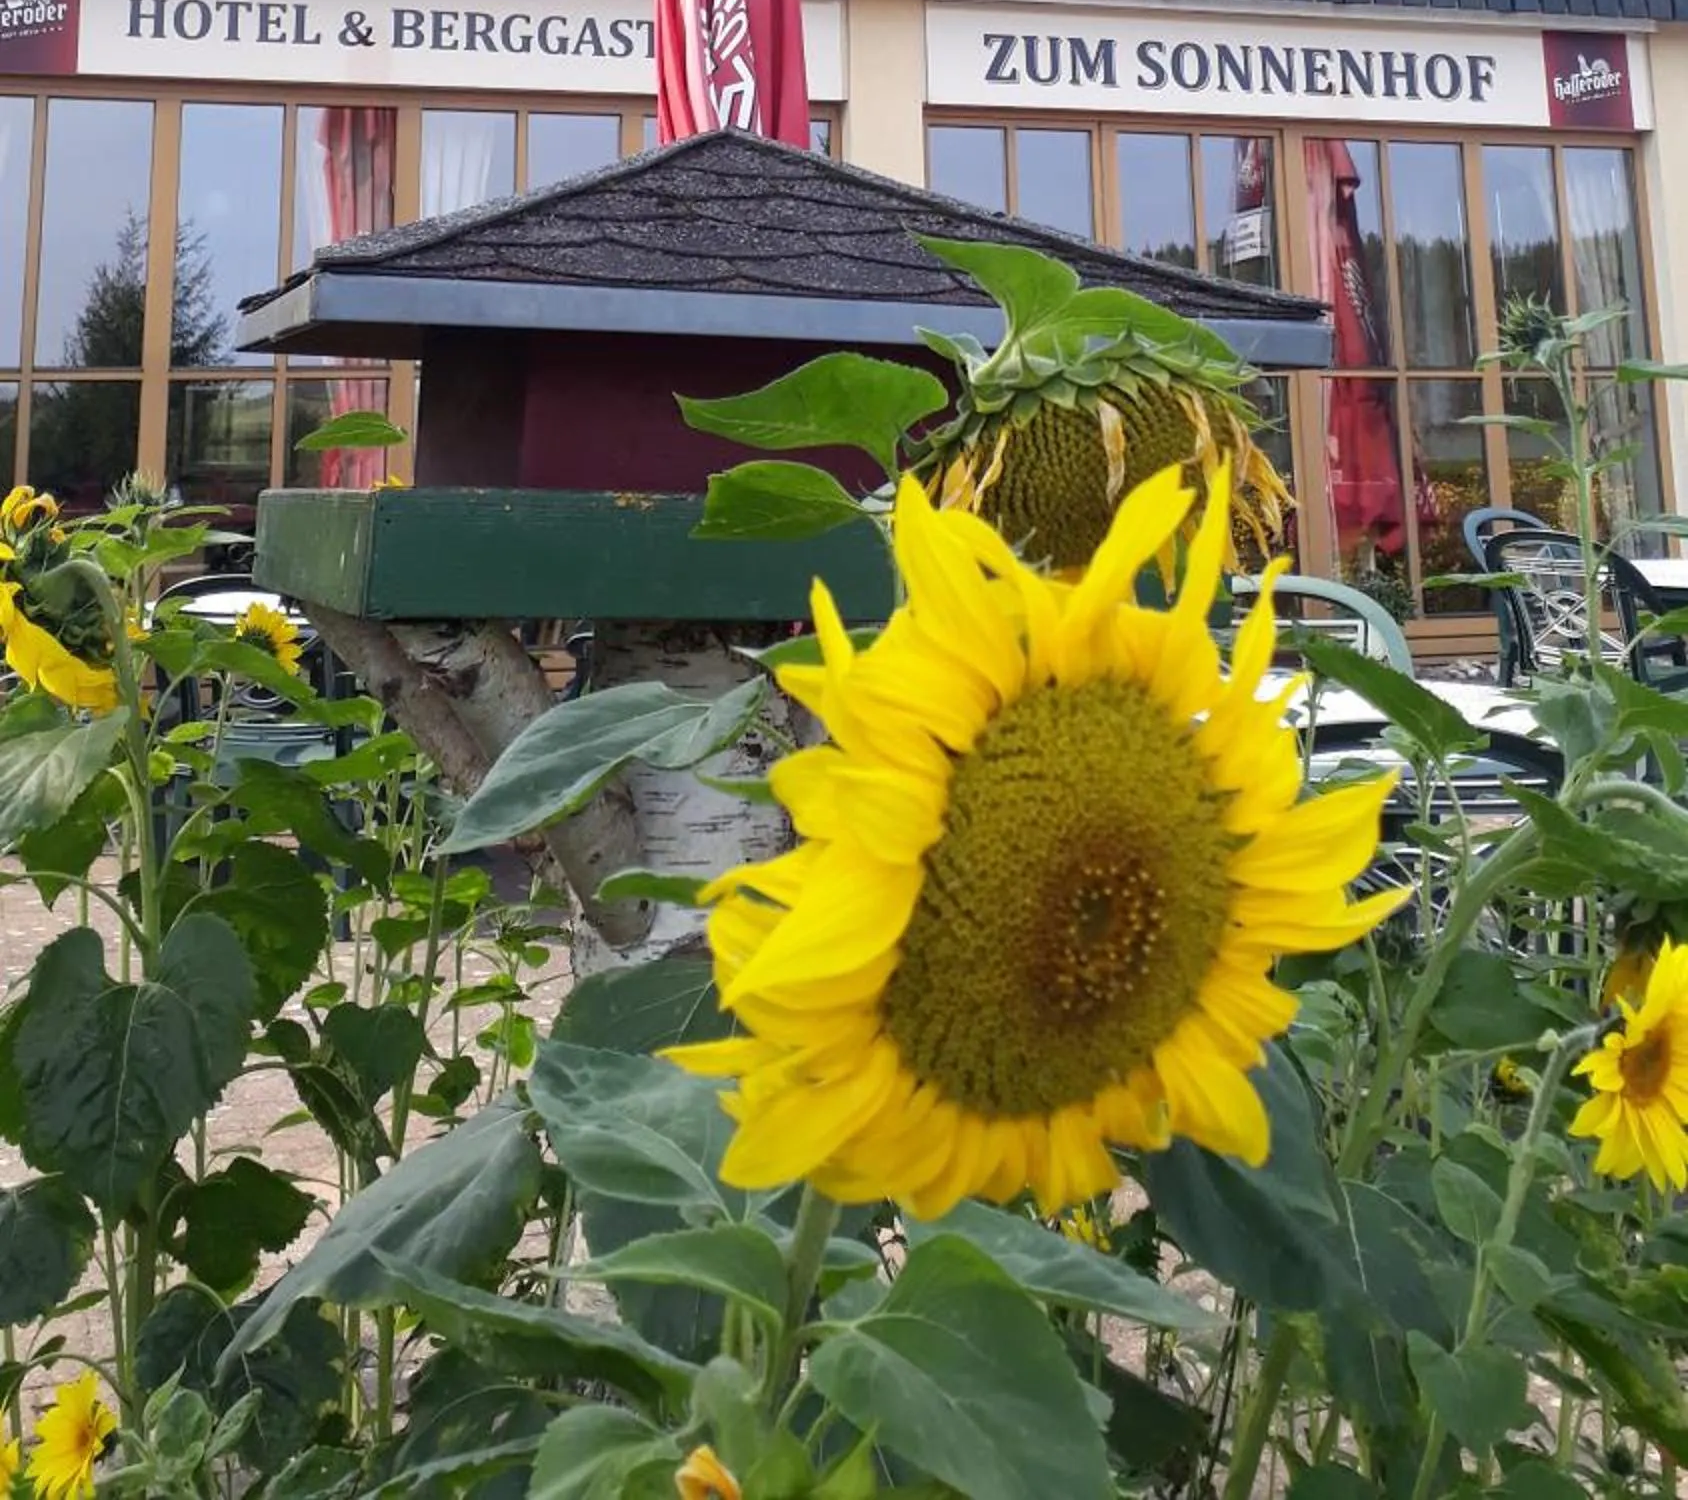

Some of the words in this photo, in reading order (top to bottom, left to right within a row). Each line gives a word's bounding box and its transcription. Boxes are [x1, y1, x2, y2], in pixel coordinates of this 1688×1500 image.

[0, 1, 68, 27] eröder
[339, 11, 376, 47] &
[983, 33, 1120, 88] ZUM
[1136, 40, 1497, 101] SONNENHOF
